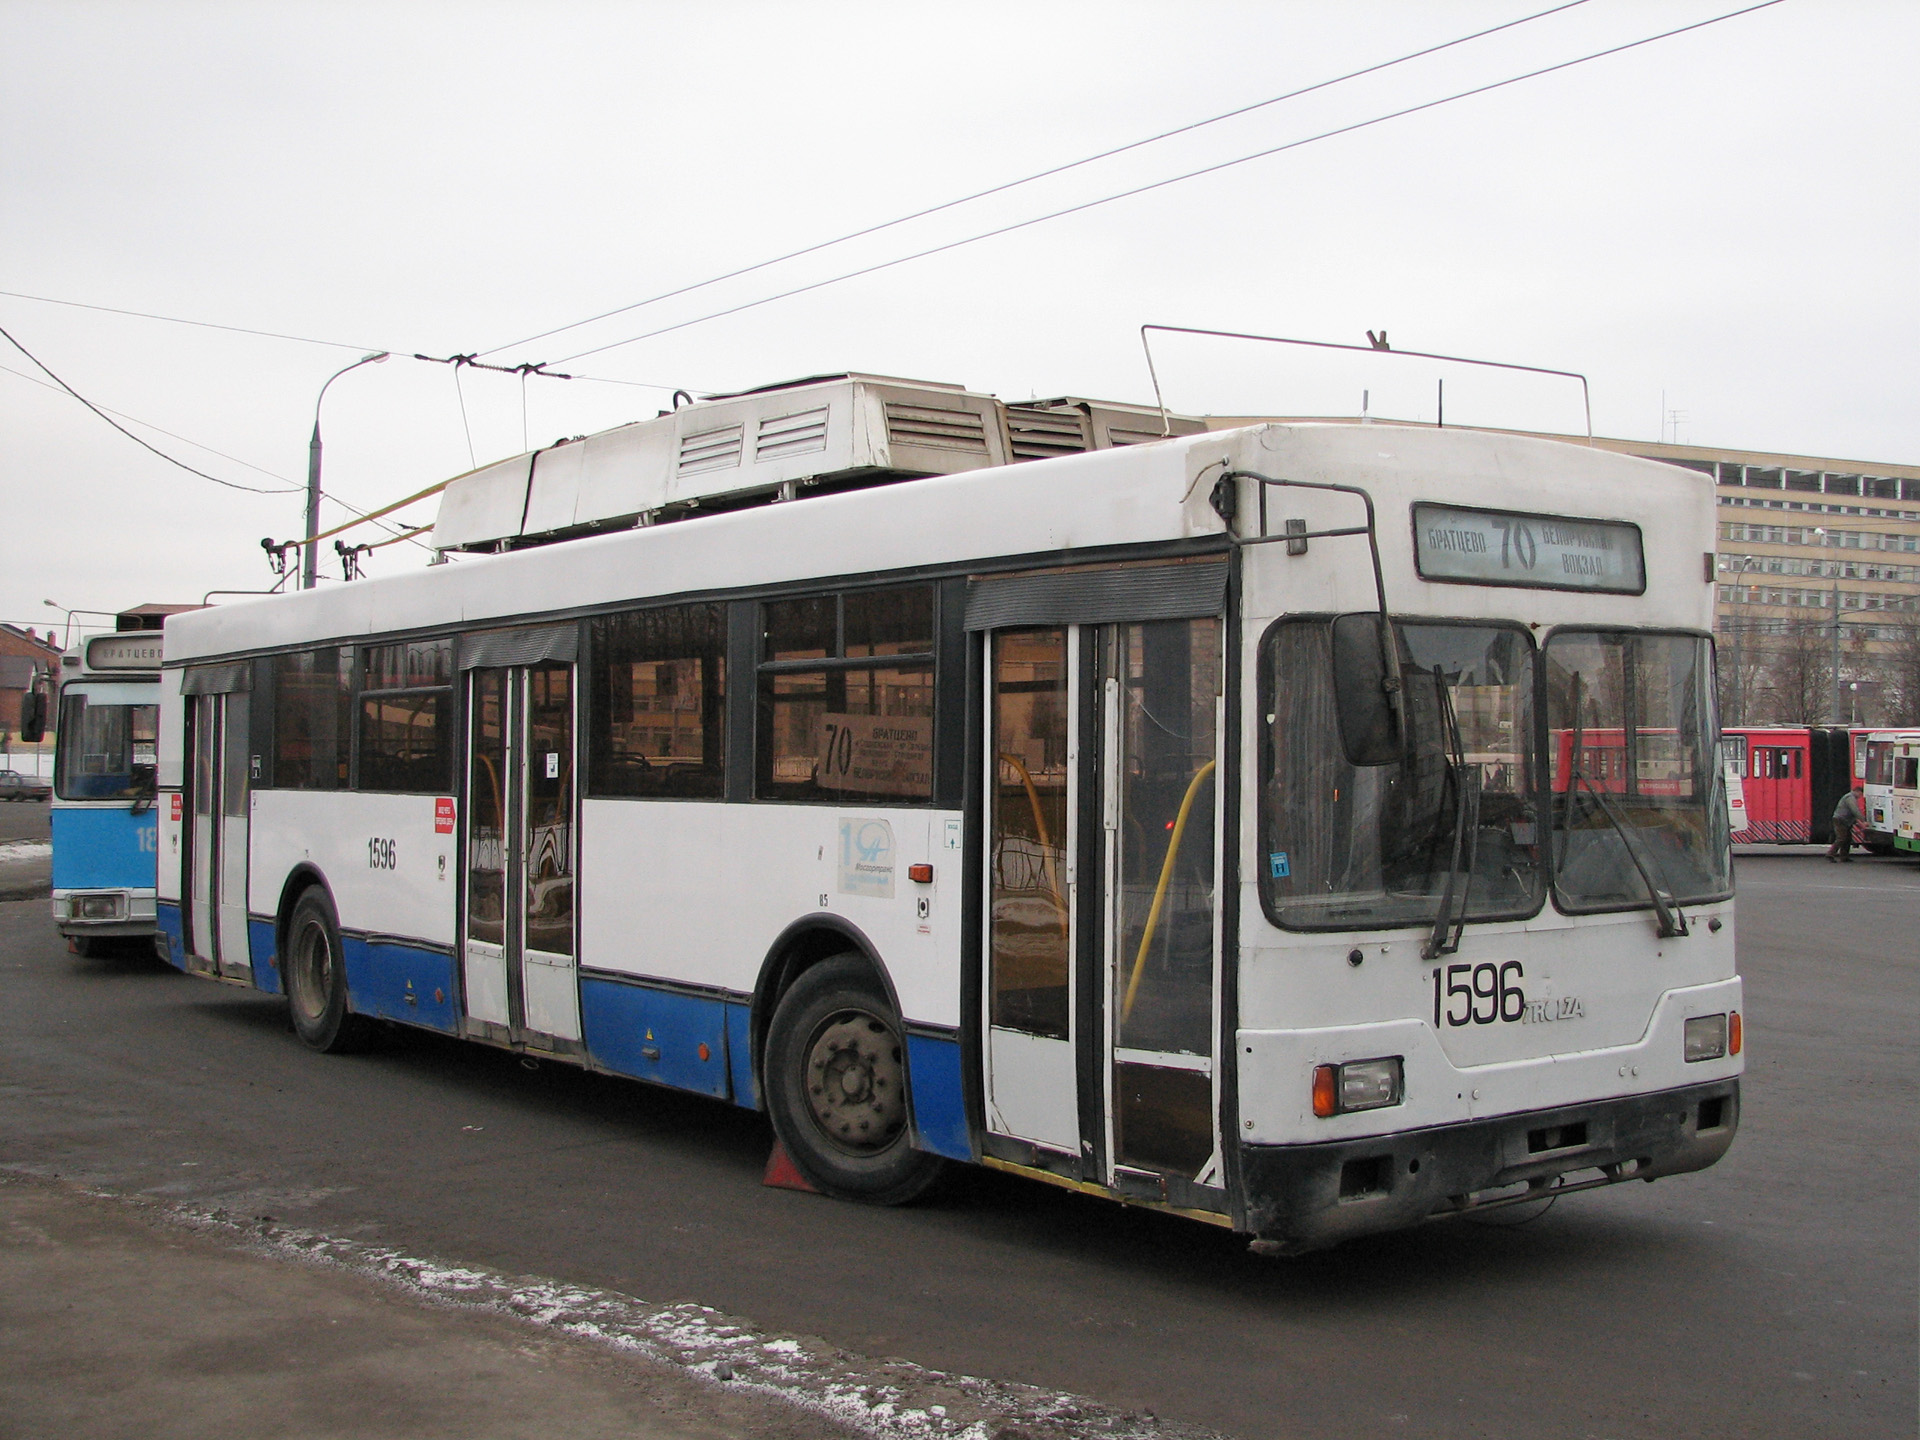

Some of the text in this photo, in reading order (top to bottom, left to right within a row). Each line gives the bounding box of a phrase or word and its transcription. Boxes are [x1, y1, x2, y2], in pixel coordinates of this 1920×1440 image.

[1427, 528, 1487, 554] БРАТЦЕВО
[1490, 518, 1537, 571] 70
[1561, 553, 1603, 577] ВОКЗАЛ
[825, 724, 852, 776] 70
[368, 836, 397, 871] 1596
[1432, 960, 1525, 1029] 1596
